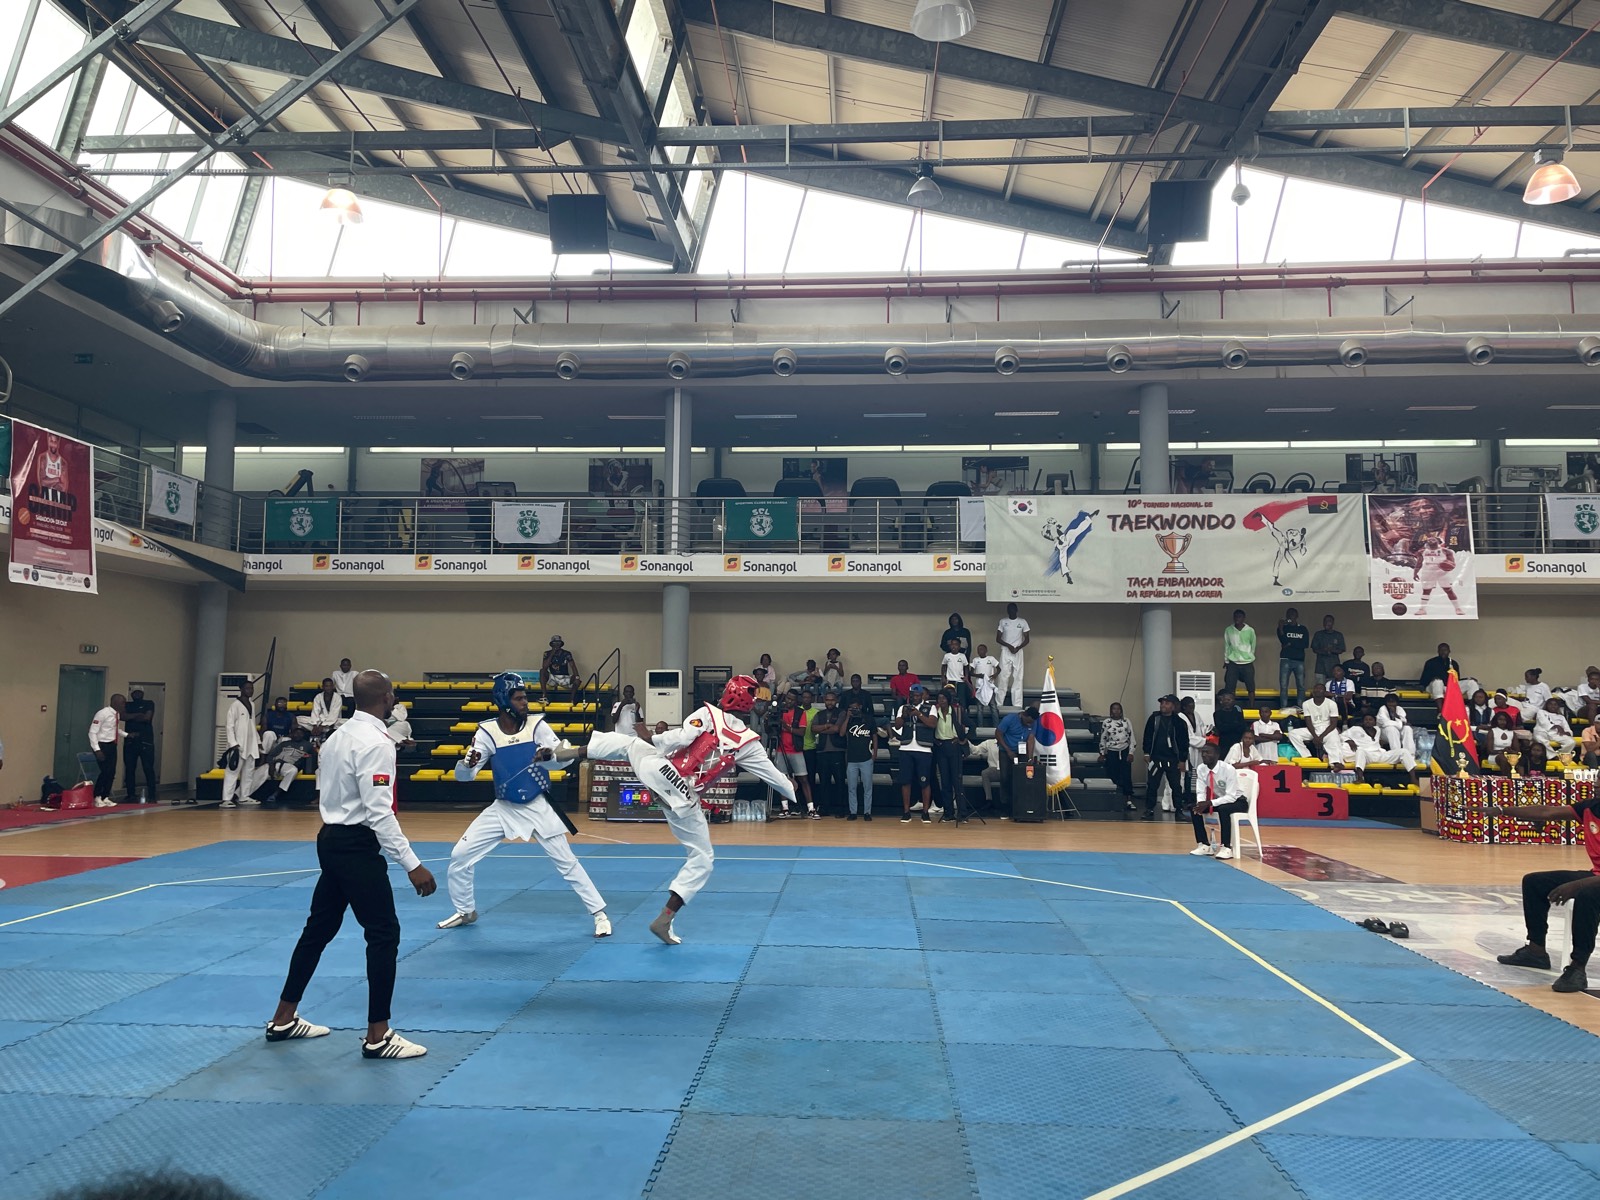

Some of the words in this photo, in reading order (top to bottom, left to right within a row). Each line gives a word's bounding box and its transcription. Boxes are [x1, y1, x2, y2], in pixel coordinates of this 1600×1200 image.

[292, 507, 310, 515] SCL
[752, 507, 770, 516] SCL
[1106, 514, 1236, 532] TAEKWONDO
[94, 528, 114, 542] ngol
[332, 559, 384, 572] Sonangol
[434, 559, 487, 573] Sonangol
[537, 559, 590, 573] Sonangol
[640, 560, 693, 574] Sonangol
[744, 560, 797, 574] Sonangol
[847, 561, 902, 574] Sonangol
[1527, 561, 1587, 575] Sonangol
[1127, 577, 1154, 588] TAÇA
[1157, 577, 1225, 587] EMBAIXADOR
[1127, 590, 1138, 598] DA
[1139, 589, 1180, 598] REPÚBLICA
[1182, 590, 1193, 598] DA
[1195, 590, 1222, 598] COREIA
[1273, 770, 1290, 792] 1
[1316, 793, 1334, 816] 3
